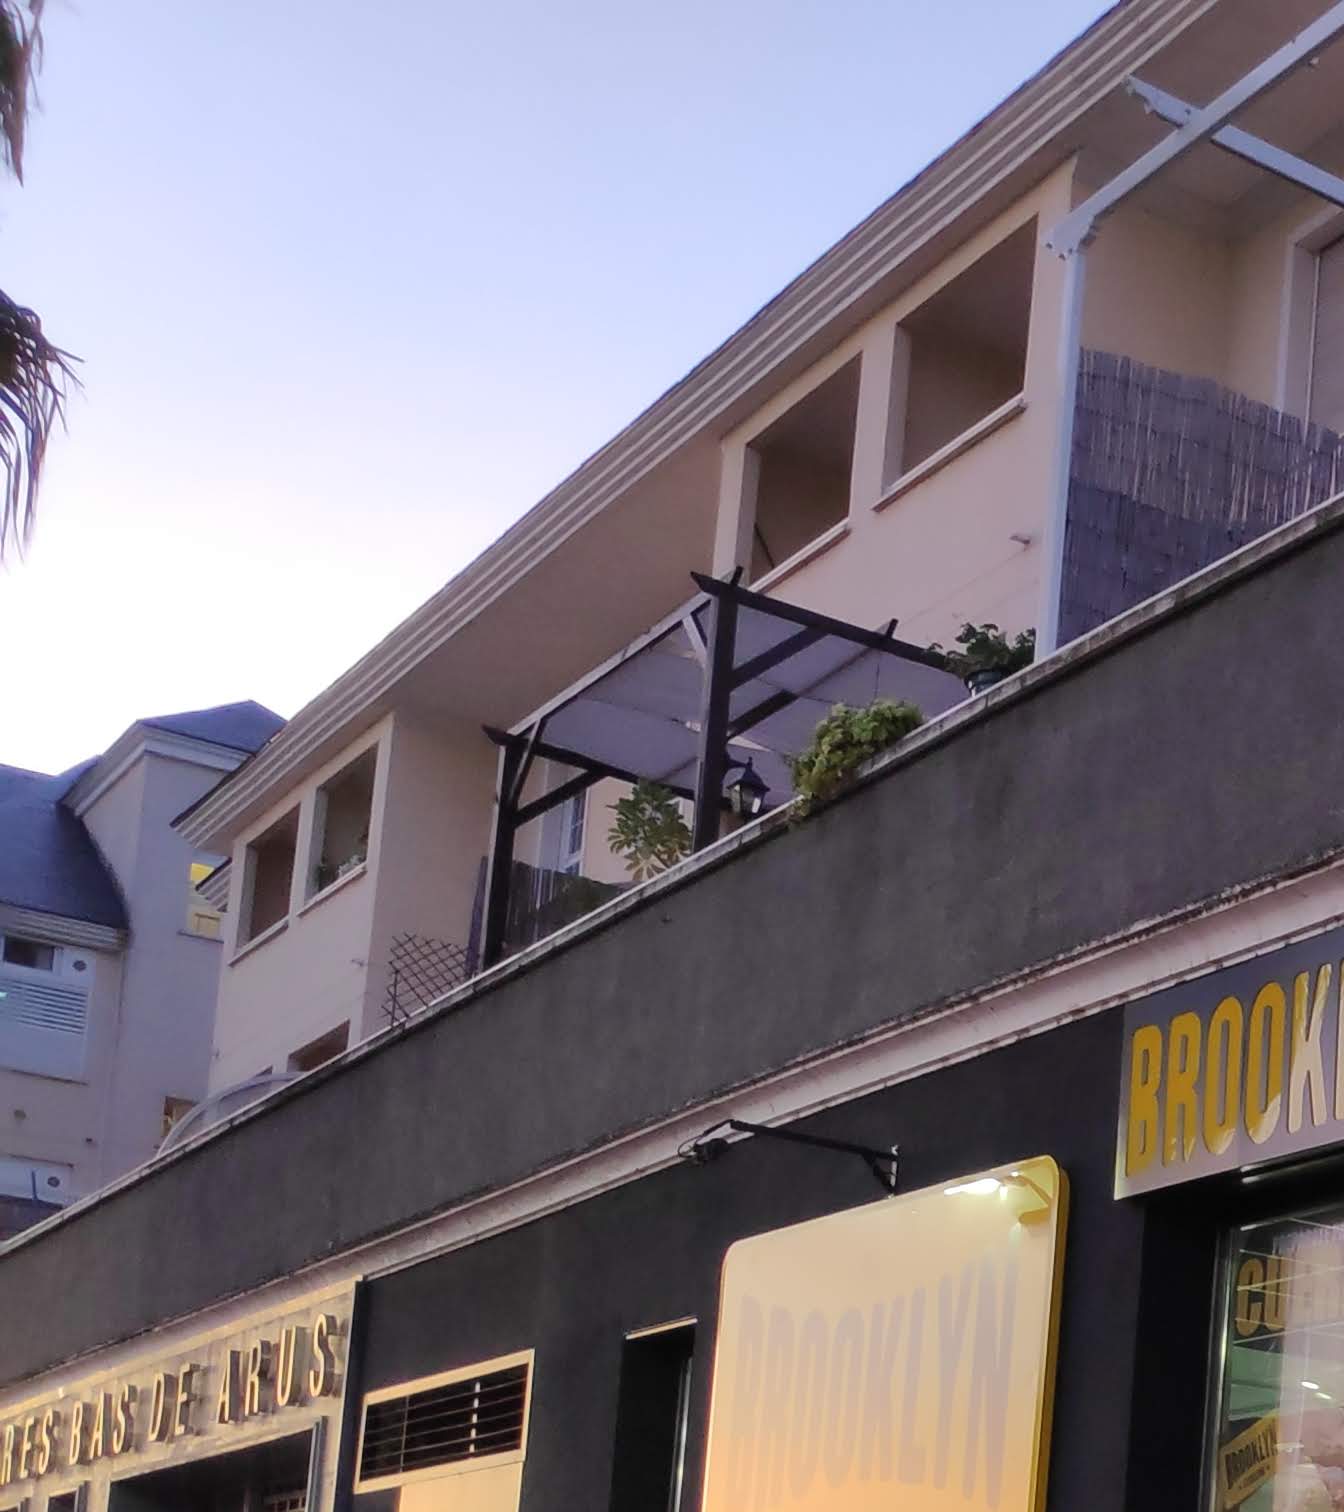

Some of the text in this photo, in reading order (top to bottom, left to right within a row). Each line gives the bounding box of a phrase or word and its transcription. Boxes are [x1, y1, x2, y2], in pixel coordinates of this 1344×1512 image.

[69, 1384, 134, 1466] BAS
[149, 1363, 199, 1442] DE
[217, 1314, 335, 1424] ARUS
